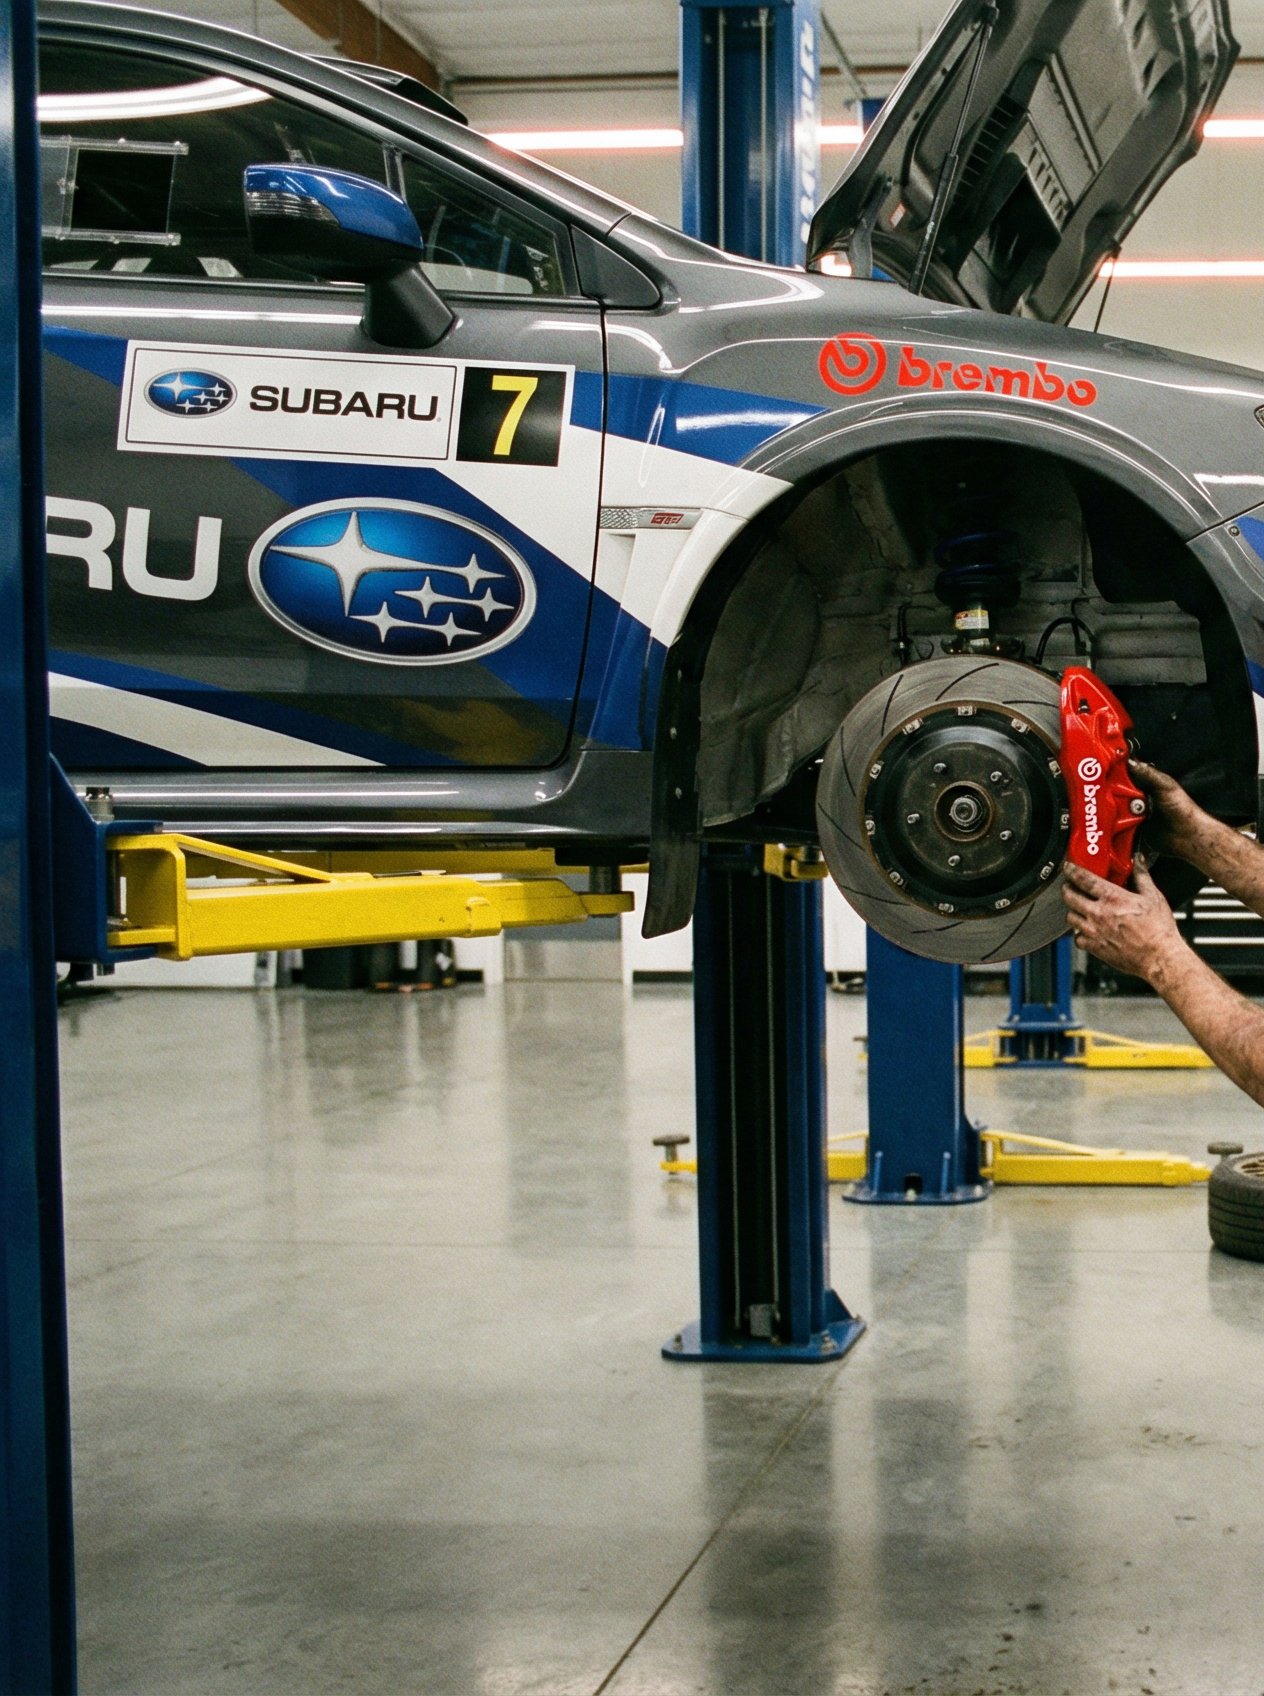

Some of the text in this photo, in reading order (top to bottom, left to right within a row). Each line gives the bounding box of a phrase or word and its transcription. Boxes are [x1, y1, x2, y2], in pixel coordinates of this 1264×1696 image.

[250, 385, 438, 421] SUBARU
[897, 346, 1097, 407] brembo
[491, 375, 538, 456] 7
[1083, 784, 1104, 856] brembo
